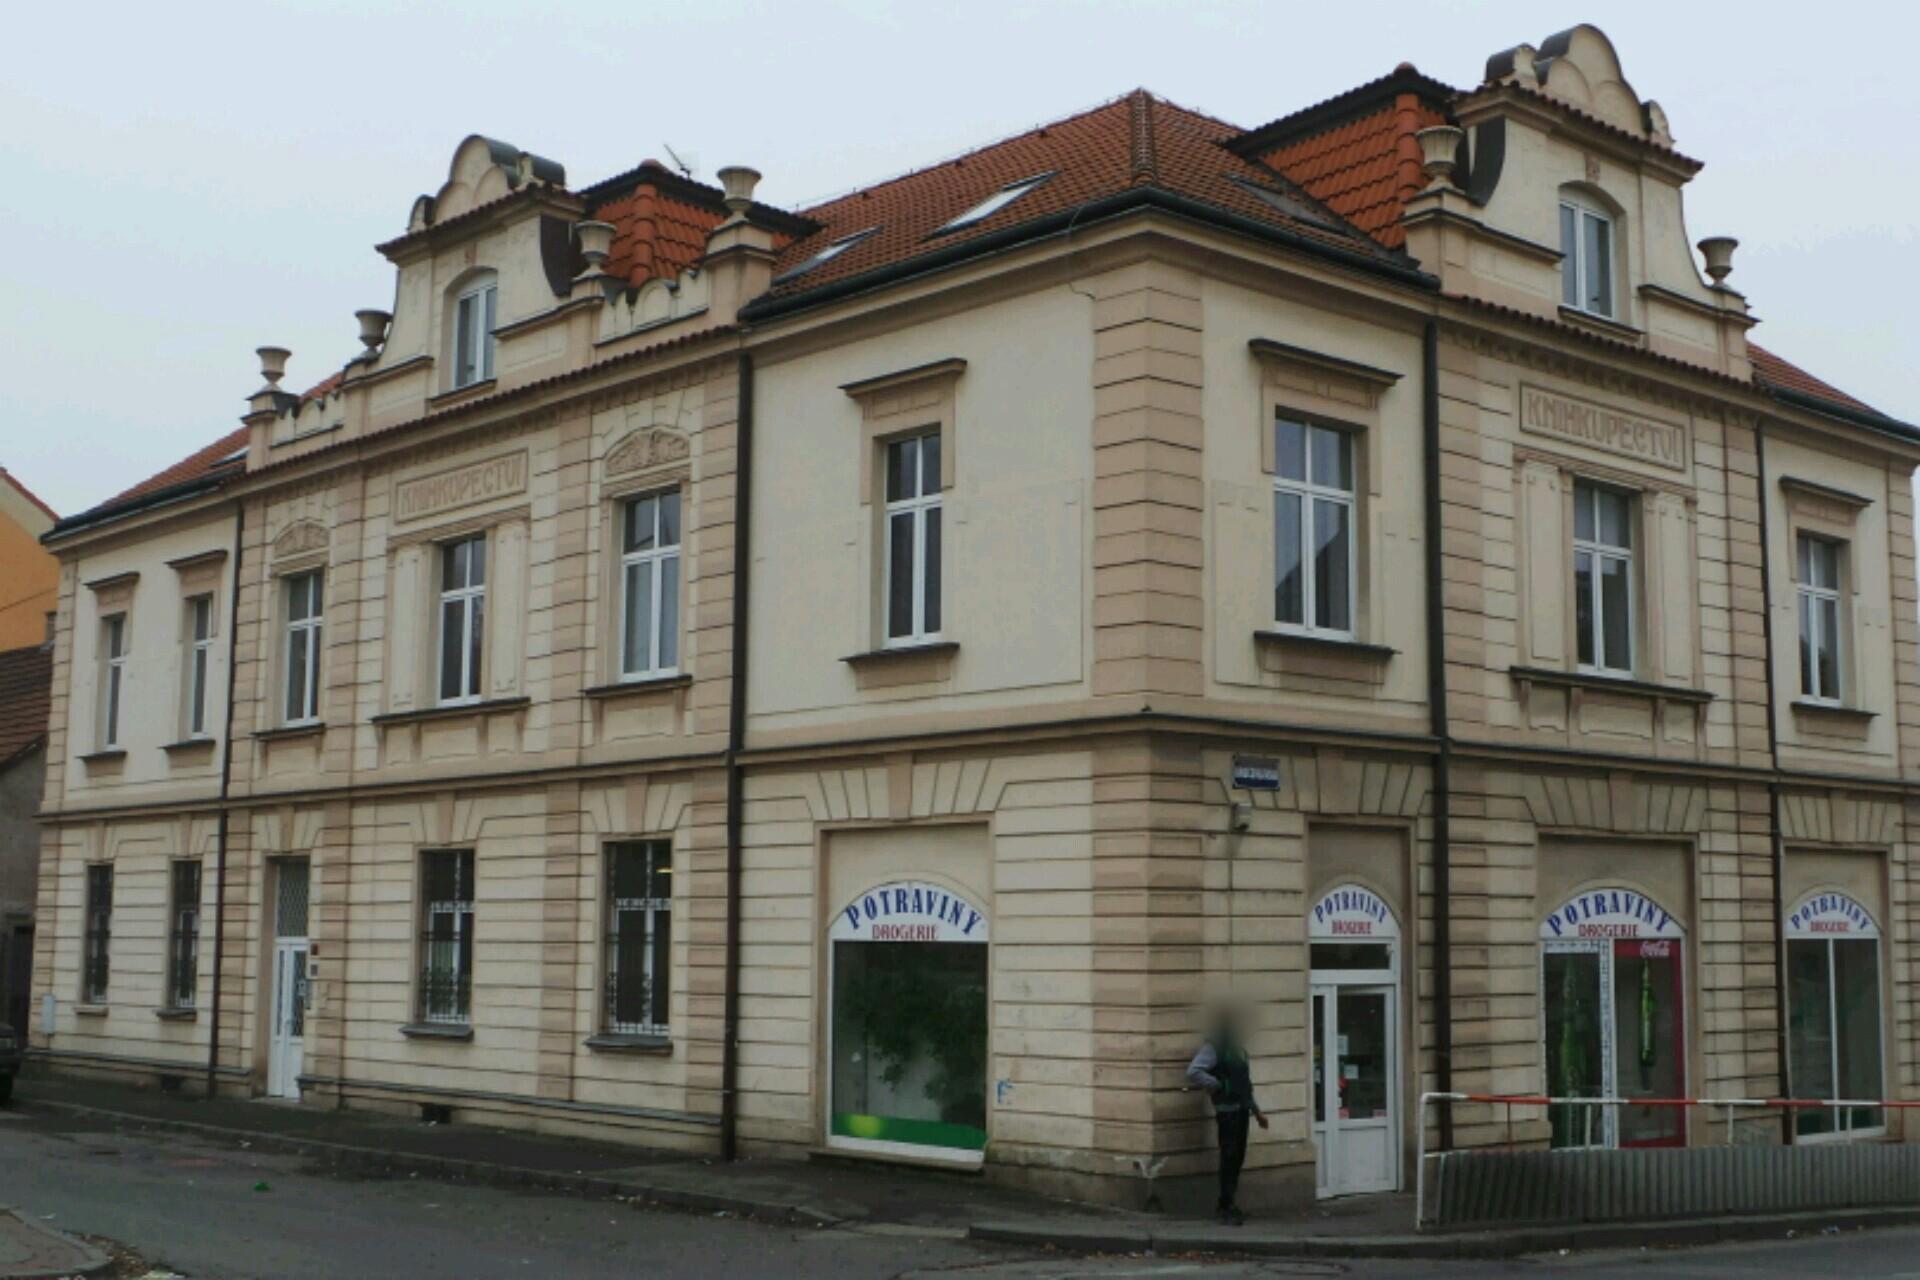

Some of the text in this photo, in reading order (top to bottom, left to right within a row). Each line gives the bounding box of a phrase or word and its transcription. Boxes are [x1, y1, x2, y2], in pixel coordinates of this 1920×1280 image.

[845, 887, 982, 935] POTRAVINY
[1314, 891, 1388, 923] POTRAVINY
[1547, 891, 1671, 936] POTRAVINY
[1790, 895, 1870, 930] POTRAVINY
[872, 924, 938, 940] DROGERIE
[1578, 924, 1640, 937] DROGERIE
